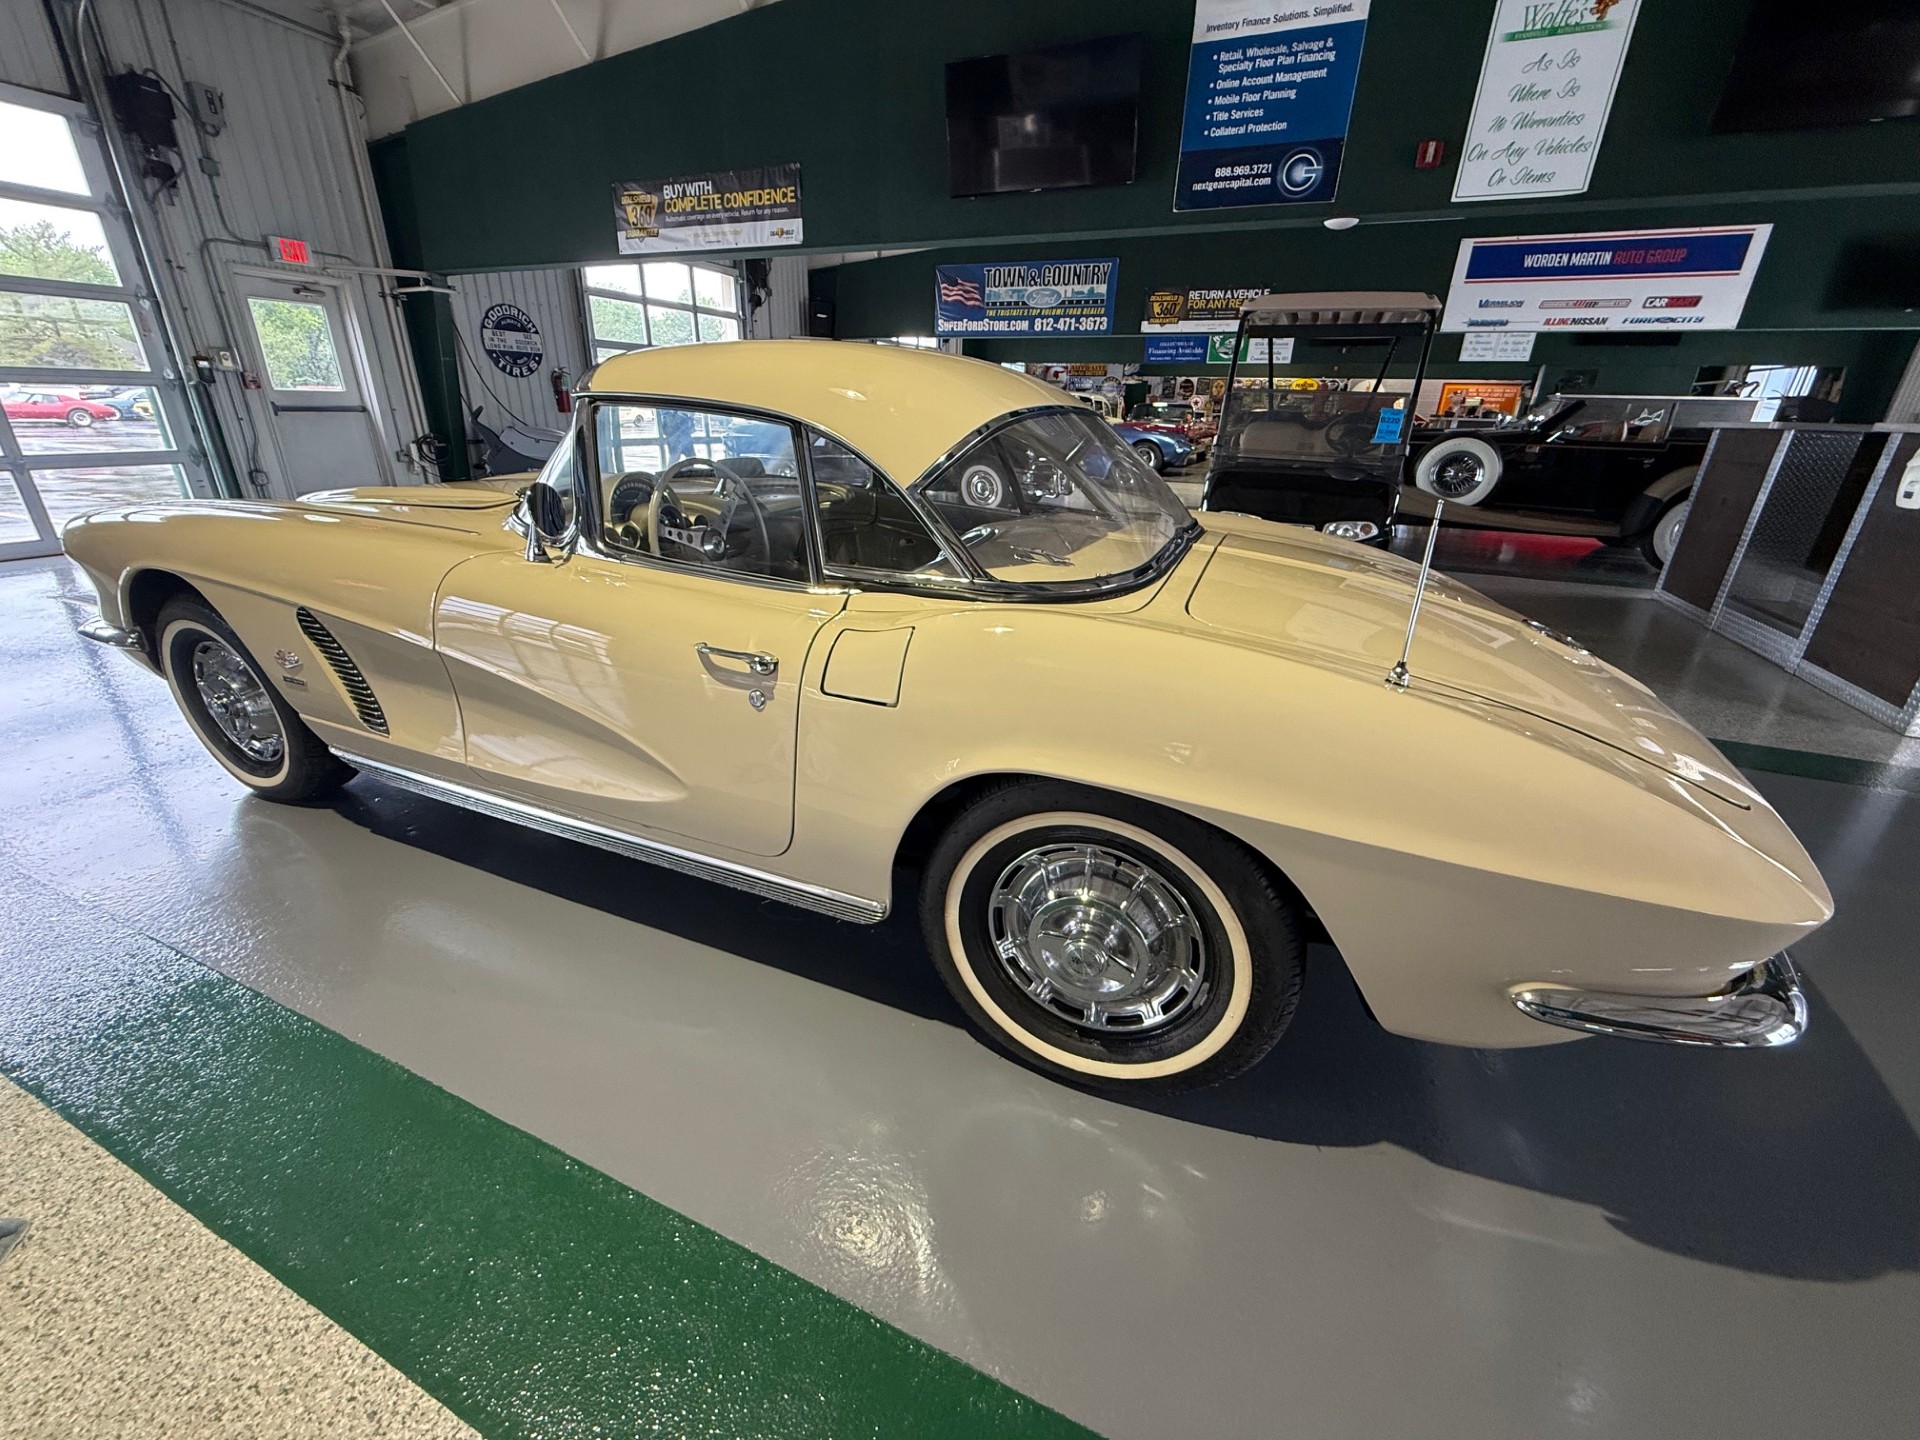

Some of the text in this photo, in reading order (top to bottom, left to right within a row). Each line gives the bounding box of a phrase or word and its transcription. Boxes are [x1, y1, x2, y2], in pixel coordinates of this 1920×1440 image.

[1206, 3, 1354, 33] Inventory Finance Solutions. Simplified.
[1219, 37, 1334, 62] Retail, Wholesale, Salvage &
[1218, 49, 1336, 75] Specialty Floor Plan Financing
[1522, 48, 1581, 73] As Is
[1216, 67, 1327, 90] Online Account Management
[1213, 87, 1297, 106] Mobile Floor Planning
[1508, 78, 1581, 103] Where Is
[1212, 107, 1264, 121] Title Services
[1487, 109, 1586, 133] No Warranties
[1210, 121, 1288, 137] Collateral Protection
[1467, 135, 1593, 166] On Any Vehicles
[1214, 163, 1272, 178] 888.969.3721
[1509, 166, 1556, 185] Items
[663, 181, 712, 199] BUY WITH
[1192, 176, 1271, 192] nextgearcapital.com
[664, 186, 796, 213] COMPLETE CONFIDENCE
[741, 207, 756, 216] Return
[772, 205, 790, 213] reason.
[280, 238, 309, 263] EXIT
[1524, 249, 1687, 267] WORDEN MARTIN AUTO GROUP
[984, 264, 1112, 288] TOWN & COUNTRY
[1030, 290, 1058, 304] Ford
[1189, 290, 1226, 299] RETURN
[1225, 290, 1233, 299] A
[1479, 299, 1525, 308] VERMILION
[1187, 300, 1206, 309] FOR
[1207, 299, 1228, 309] ANY
[484, 305, 537, 333] GOODRICH
[1034, 317, 1108, 331] 812-471-3673
[1570, 317, 1609, 325] NISSAN
[499, 359, 538, 376] TIRES
